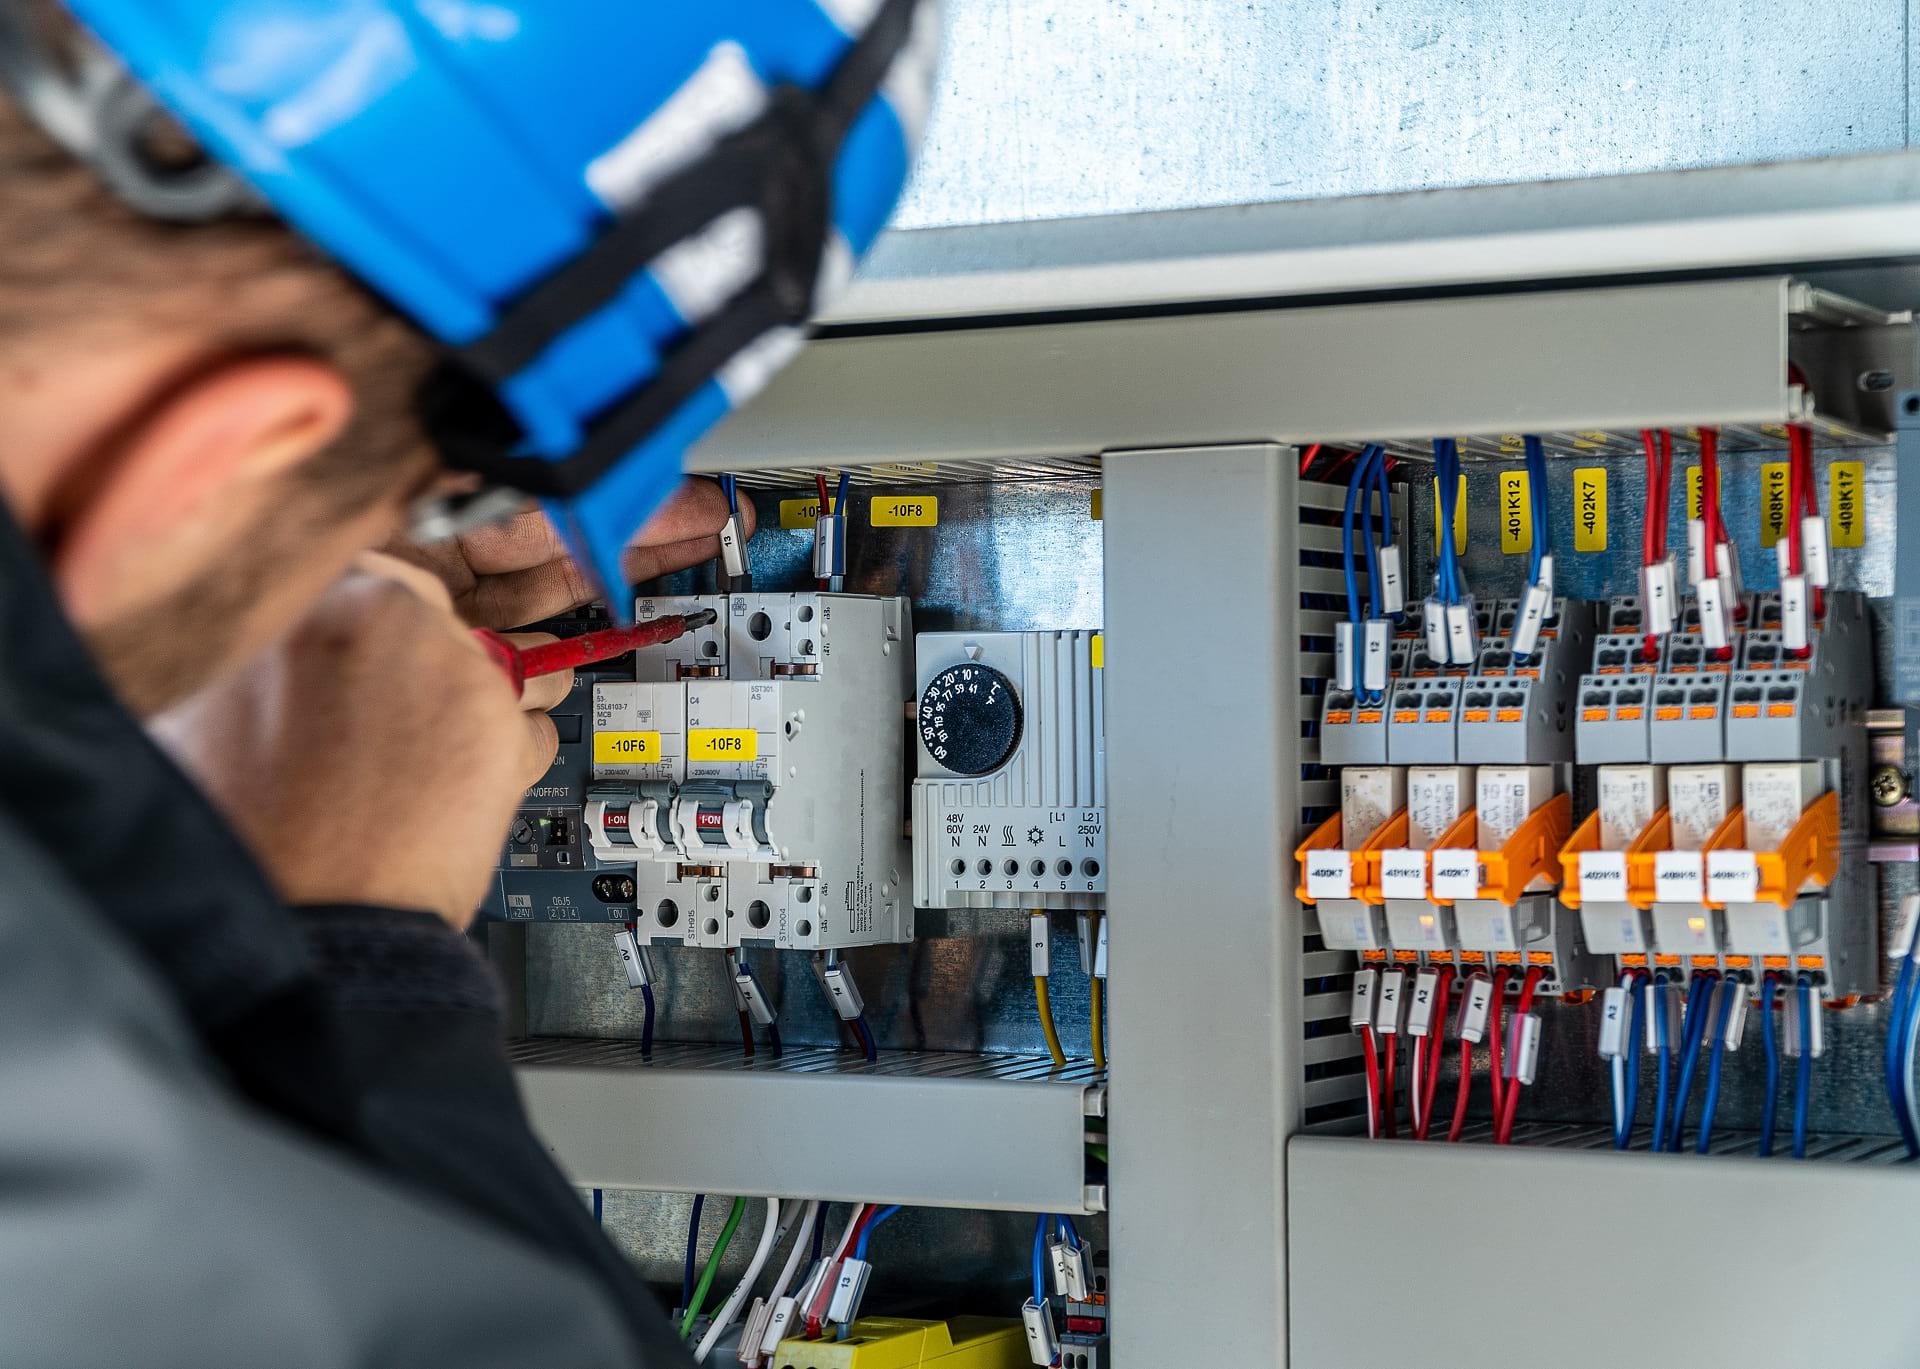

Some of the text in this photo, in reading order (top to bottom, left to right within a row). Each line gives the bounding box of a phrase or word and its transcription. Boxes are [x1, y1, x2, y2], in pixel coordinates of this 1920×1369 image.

[889, 505, 922, 516] -10F8
[1508, 480, 1520, 540] -401K12
[1583, 482, 1596, 534] -402K7
[724, 535, 731, 547] 13
[942, 673, 954, 687] 20
[962, 669, 972, 680] 10
[928, 686, 940, 700] 30
[955, 684, 964, 694] 59
[969, 683, 977, 694] 41
[942, 689, 952, 701] 77
[922, 706, 933, 719] 40
[936, 702, 945, 712] 95
[690, 718, 699, 726] C4
[934, 716, 943, 728] 113
[924, 727, 935, 740] 50
[937, 730, 948, 742] 131
[611, 740, 645, 752] -10F6
[706, 738, 741, 750] -10F8
[934, 746, 947, 759] 60
[525, 788, 569, 798] ON/OFF/RST
[608, 816, 626, 824] I-ON
[702, 816, 721, 824] I-ON
[946, 814, 964, 822] 48V
[946, 825, 964, 834] 60V
[973, 824, 990, 834] 24V
[1078, 826, 1101, 834] 250V
[951, 836, 960, 847] N
[978, 836, 986, 846] N
[1059, 836, 1066, 847] L
[1086, 837, 1094, 847] N
[530, 844, 538, 852] 10
[980, 881, 986, 889] 2
[1006, 881, 1012, 889] 3
[1033, 881, 1039, 889] 4
[1060, 882, 1066, 890] 5
[1088, 882, 1094, 890] 6
[515, 897, 524, 905] IN
[513, 909, 530, 917] +24V
[552, 909, 576, 918] 2 3 4
[613, 910, 622, 918] 0V
[621, 949, 630, 960] 0V
[833, 987, 842, 996] 14
[1357, 983, 1367, 996] A2
[1385, 988, 1394, 1001] A1
[1418, 989, 1428, 1004] A2
[1474, 996, 1484, 1010] A1
[1608, 1005, 1617, 1020] A2
[841, 1277, 850, 1288] 13
[775, 1313, 784, 1323] 10
